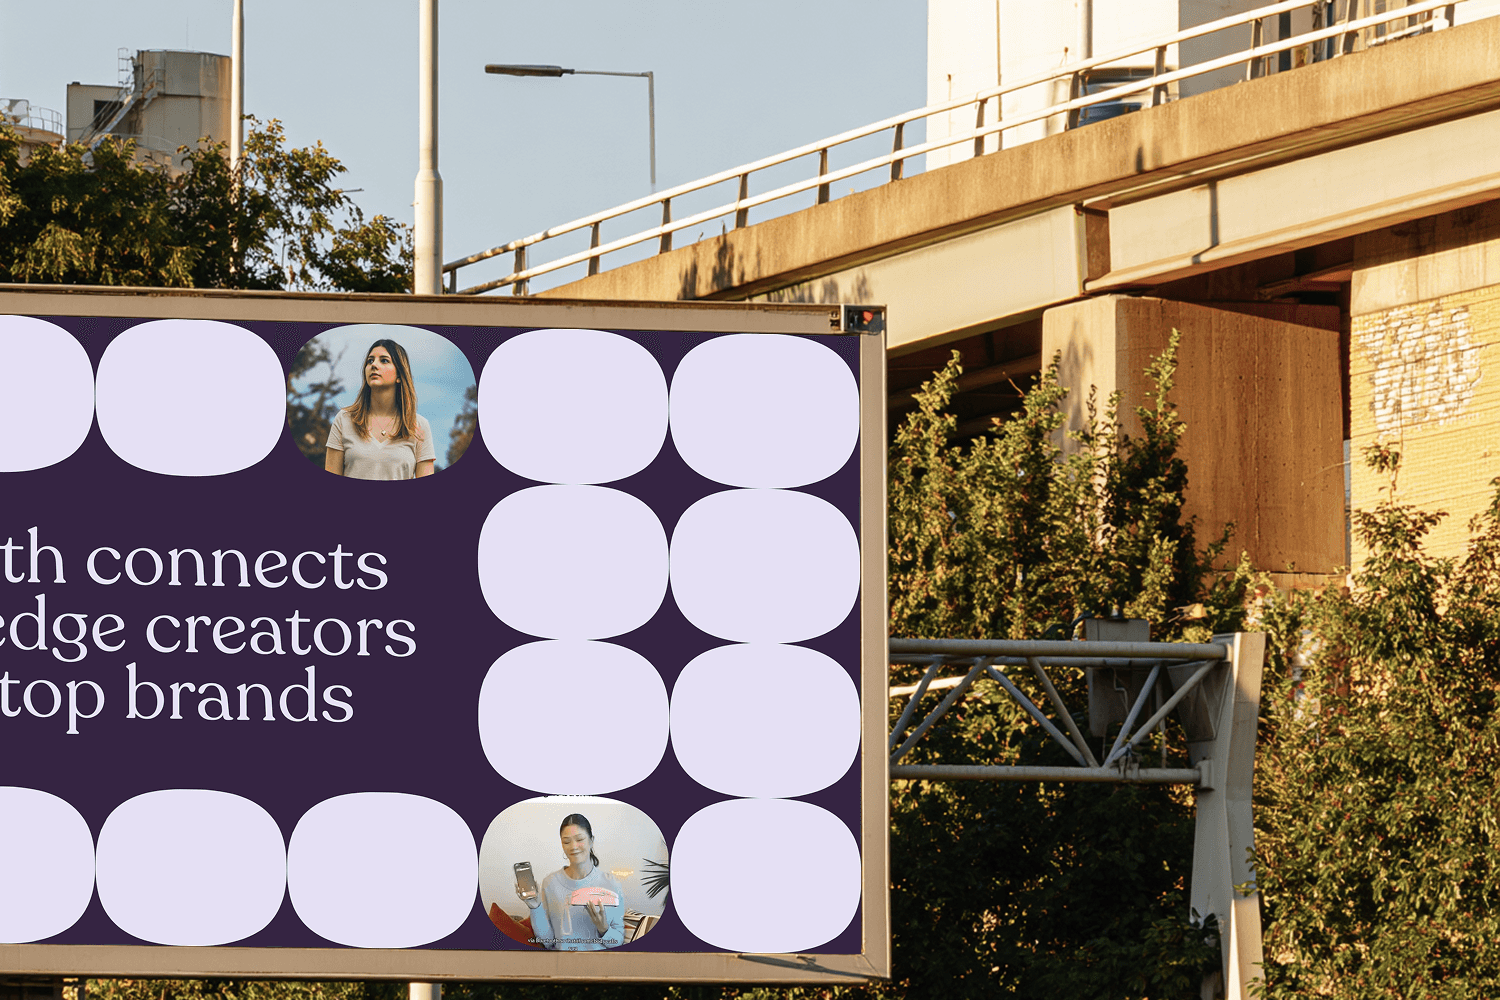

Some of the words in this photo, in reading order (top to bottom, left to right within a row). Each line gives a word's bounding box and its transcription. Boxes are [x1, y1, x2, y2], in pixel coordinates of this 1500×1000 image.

[86, 543, 388, 591] connects
[146, 609, 417, 658] creators
[125, 661, 354, 723] brands
